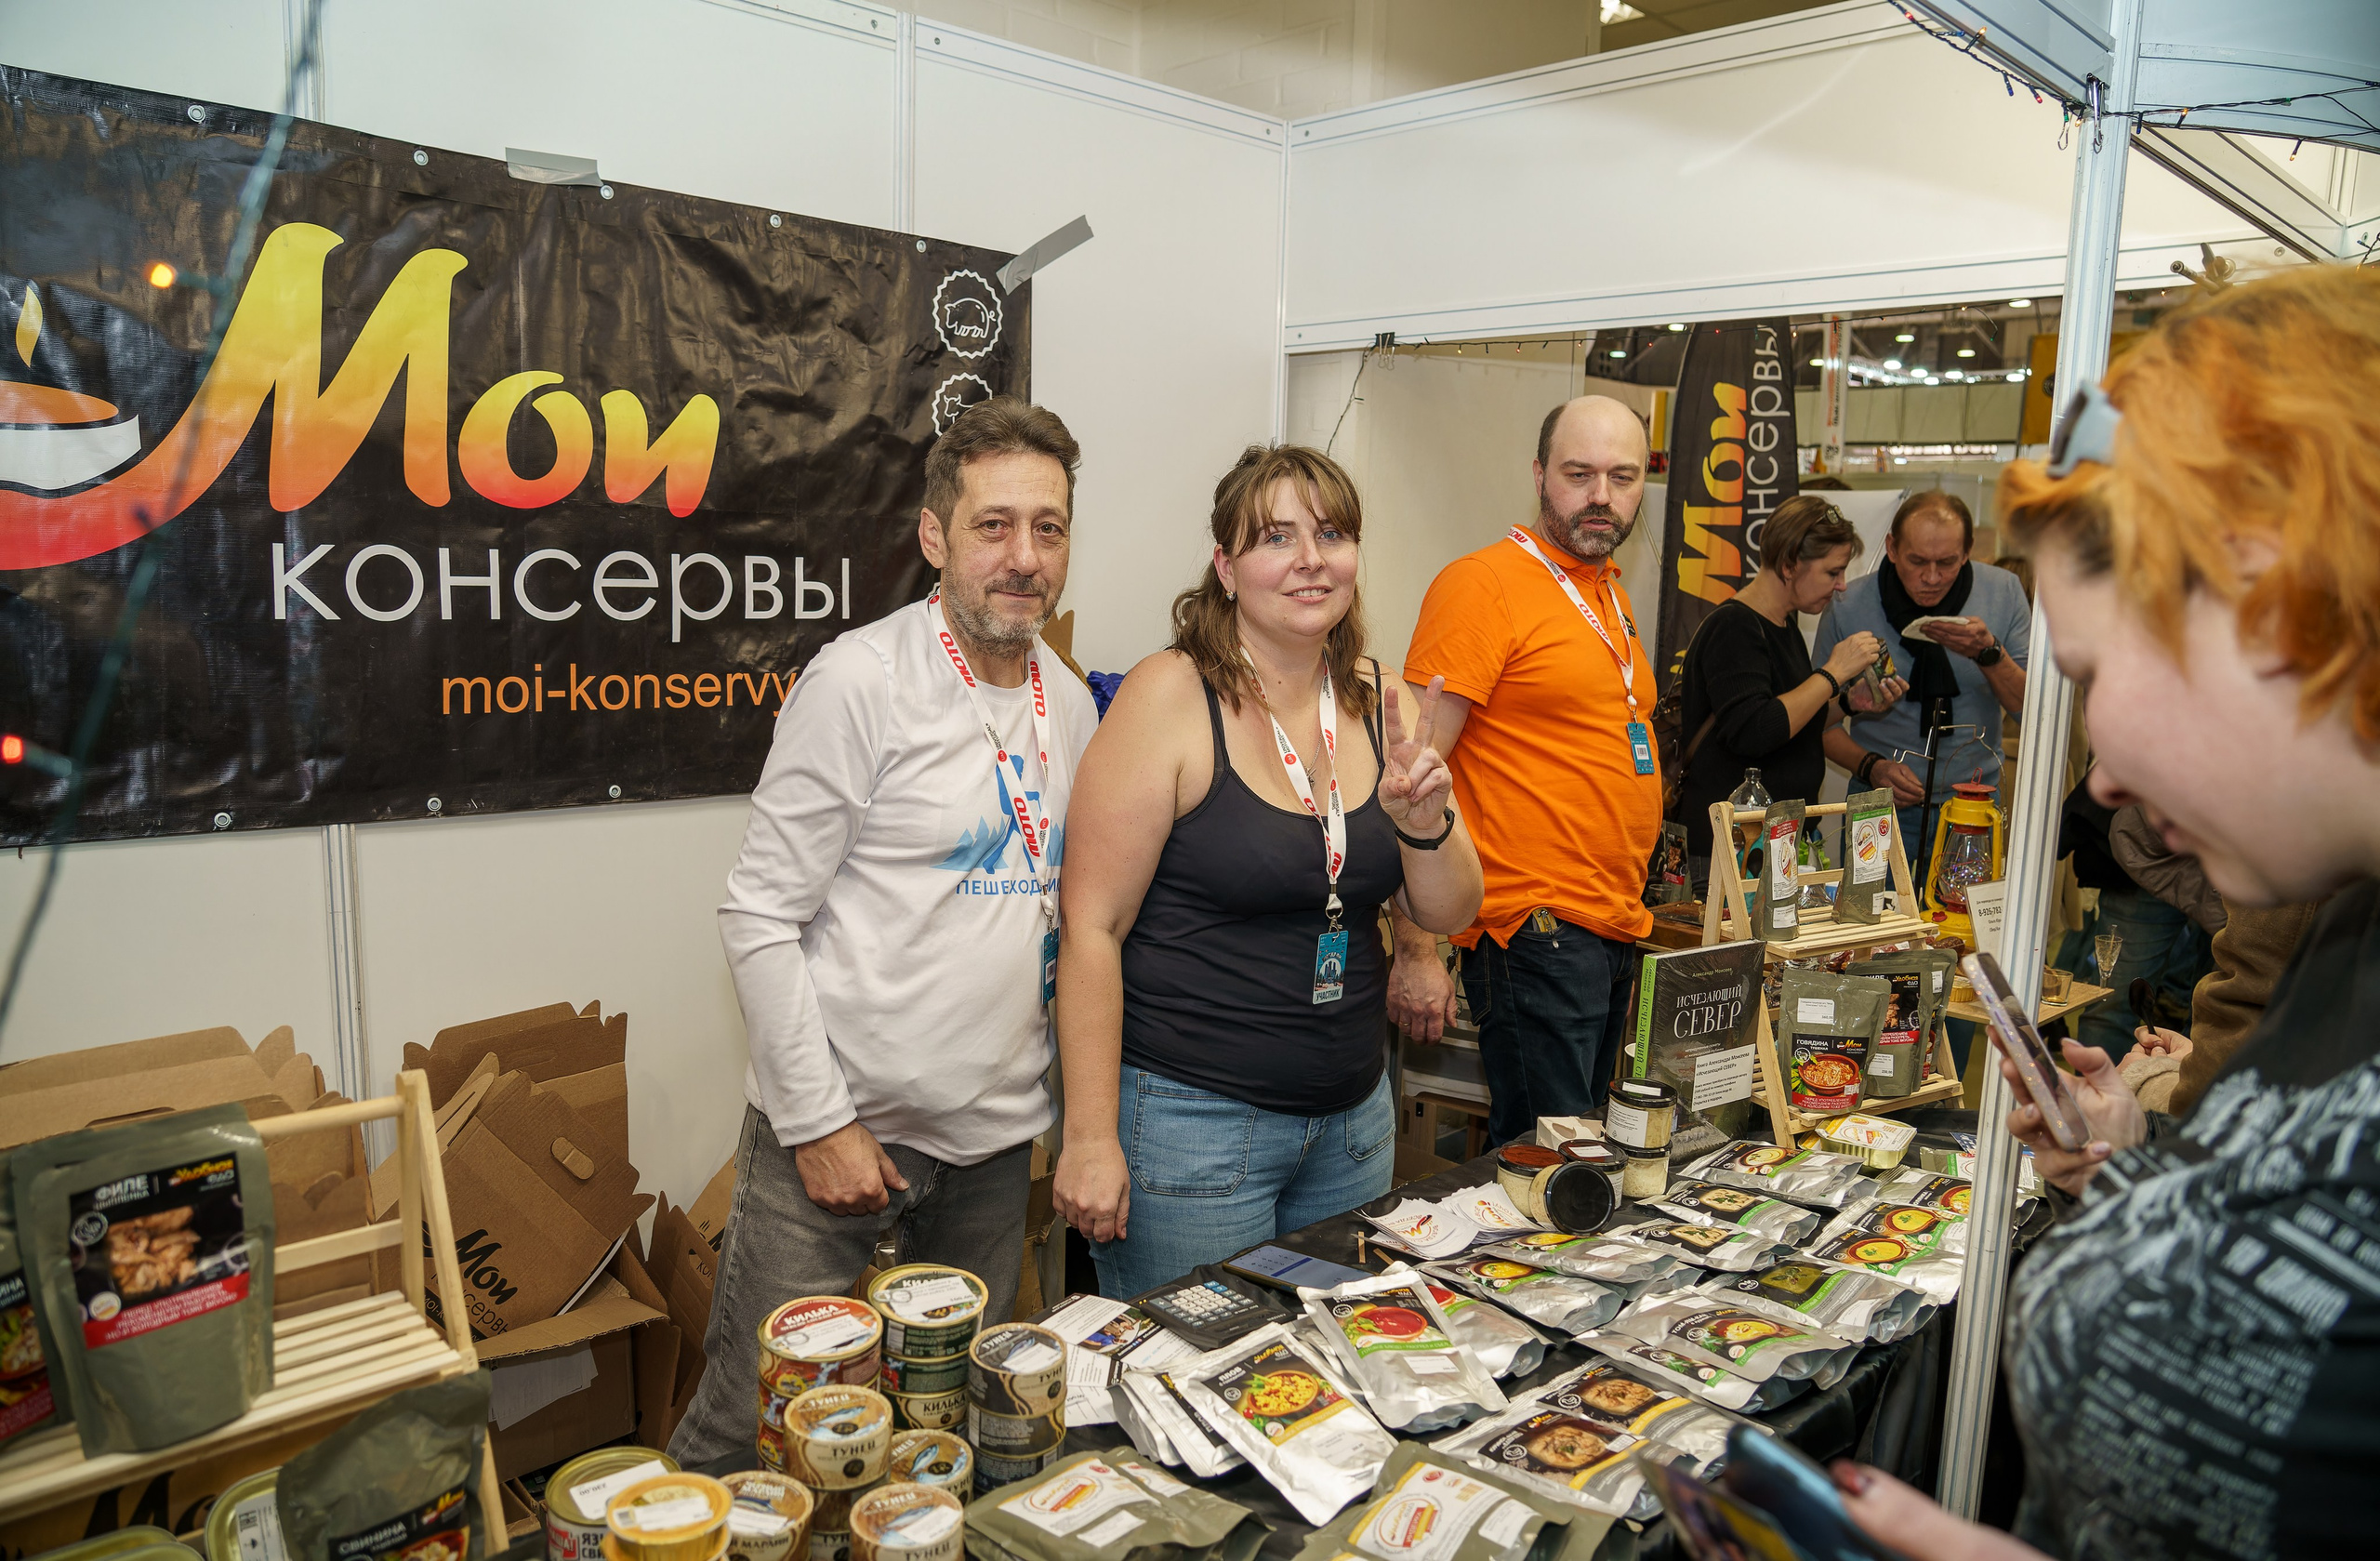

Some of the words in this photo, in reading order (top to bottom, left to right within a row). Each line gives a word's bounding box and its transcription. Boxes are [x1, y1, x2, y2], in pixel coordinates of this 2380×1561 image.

[139, 223, 721, 521] Мои
[1677, 382, 1747, 605] Мои
[271, 542, 851, 643] консервы
[940, 632, 976, 688] MOTO
[1030, 661, 1046, 717] MOTO
[1014, 797, 1040, 857] MOTO
[1316, 988, 1341, 1001] УЧАСТНИК
[1676, 984, 1742, 1008] ИСЧЕЗАЮЩИЙ
[1673, 1000, 1741, 1038] СЕВЕР
[95, 1174, 149, 1201] ФИЛЕ
[784, 1304, 840, 1327] КИЛЬКА
[982, 1330, 1013, 1350] ТУНЕЦ
[1219, 1367, 1242, 1382] ПЛОВ
[809, 1394, 851, 1408] ТУНЕЦ
[923, 1394, 966, 1412] КИЛЬКА
[832, 1440, 877, 1457] ТУНЕЦ
[875, 1492, 918, 1508] ТУНЕЦ
[906, 1541, 951, 1561] ТУНЕЦ
